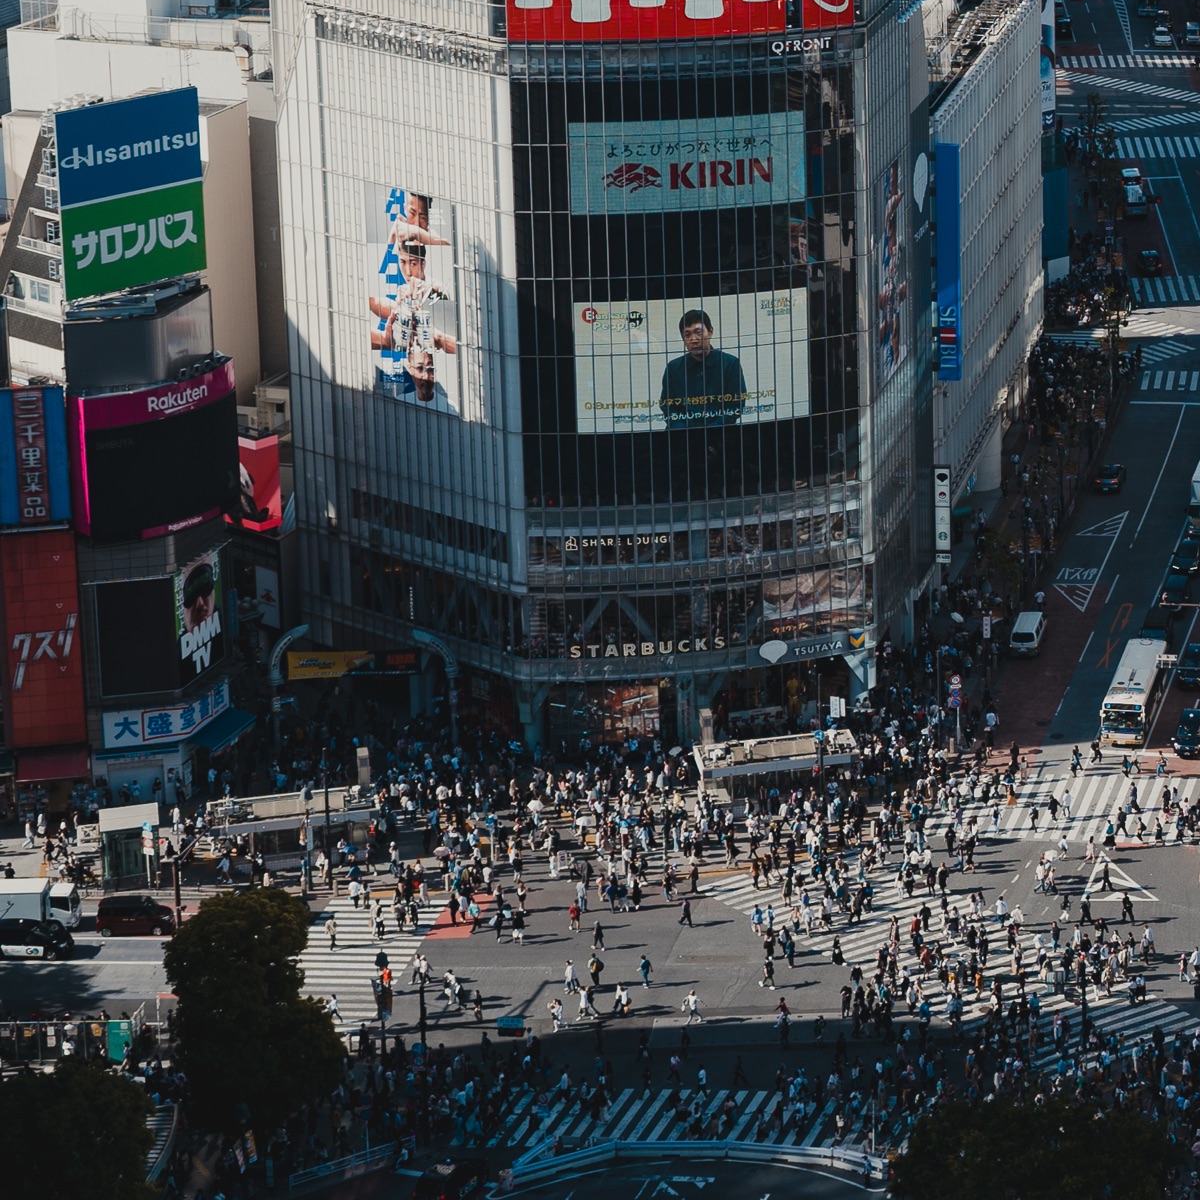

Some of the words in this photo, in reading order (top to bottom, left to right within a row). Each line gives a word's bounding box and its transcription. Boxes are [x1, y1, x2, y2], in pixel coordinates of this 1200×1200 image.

[771, 36, 832, 56] QFRONT
[60, 130, 199, 170] Hisamitsu
[606, 136, 774, 159] よろこびがつなぐ世界へ
[669, 156, 774, 190] KIRIN
[71, 210, 198, 270] サロンパス
[939, 306, 957, 369] SEIBU
[147, 384, 209, 413] Rakuten
[582, 537, 622, 548] SHARE
[180, 611, 222, 661] DMM
[570, 636, 726, 659] STARBUCKS
[794, 641, 843, 656] TSUTAYA
[192, 641, 212, 675] TV
[114, 682, 225, 742] 大盛堂書店
[26, 947, 40, 956] GO
